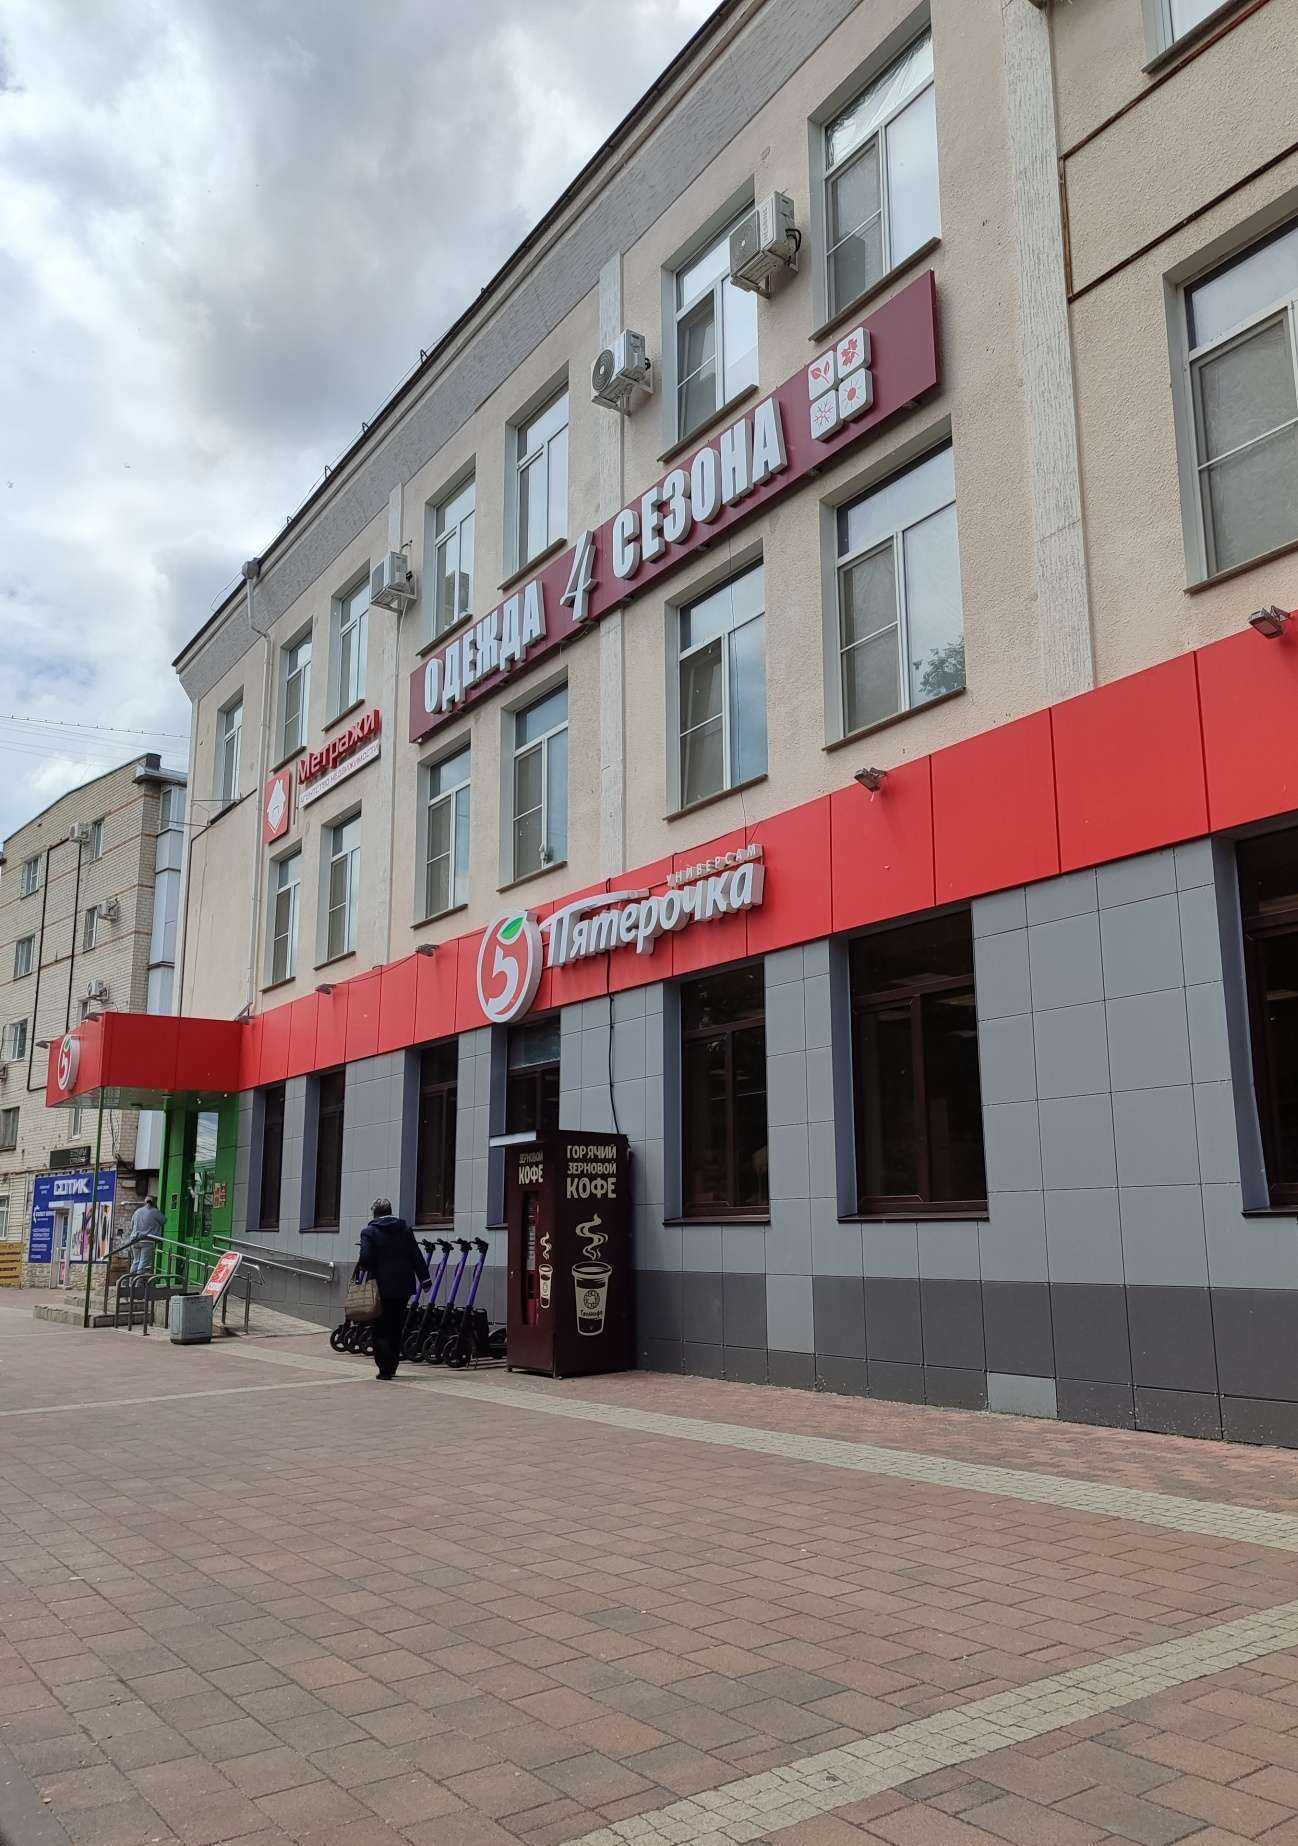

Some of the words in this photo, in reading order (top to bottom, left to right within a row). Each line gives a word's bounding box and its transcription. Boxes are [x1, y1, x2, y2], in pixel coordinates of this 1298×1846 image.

[424, 579, 546, 714] ОДЕЖДА
[560, 529, 599, 622] 4
[612, 397, 788, 580] СЕЗОНА
[298, 709, 382, 784] Метражи
[666, 843, 763, 888] УНИВЕРСАМ
[539, 862, 765, 967] Пятерочка
[567, 1144, 617, 1159] ГОРЯЧИЙ
[567, 1161, 617, 1174] ЗЕРНОВОЙ
[518, 1164, 544, 1185] КОФЕ
[566, 1177, 617, 1198] КОФЕ
